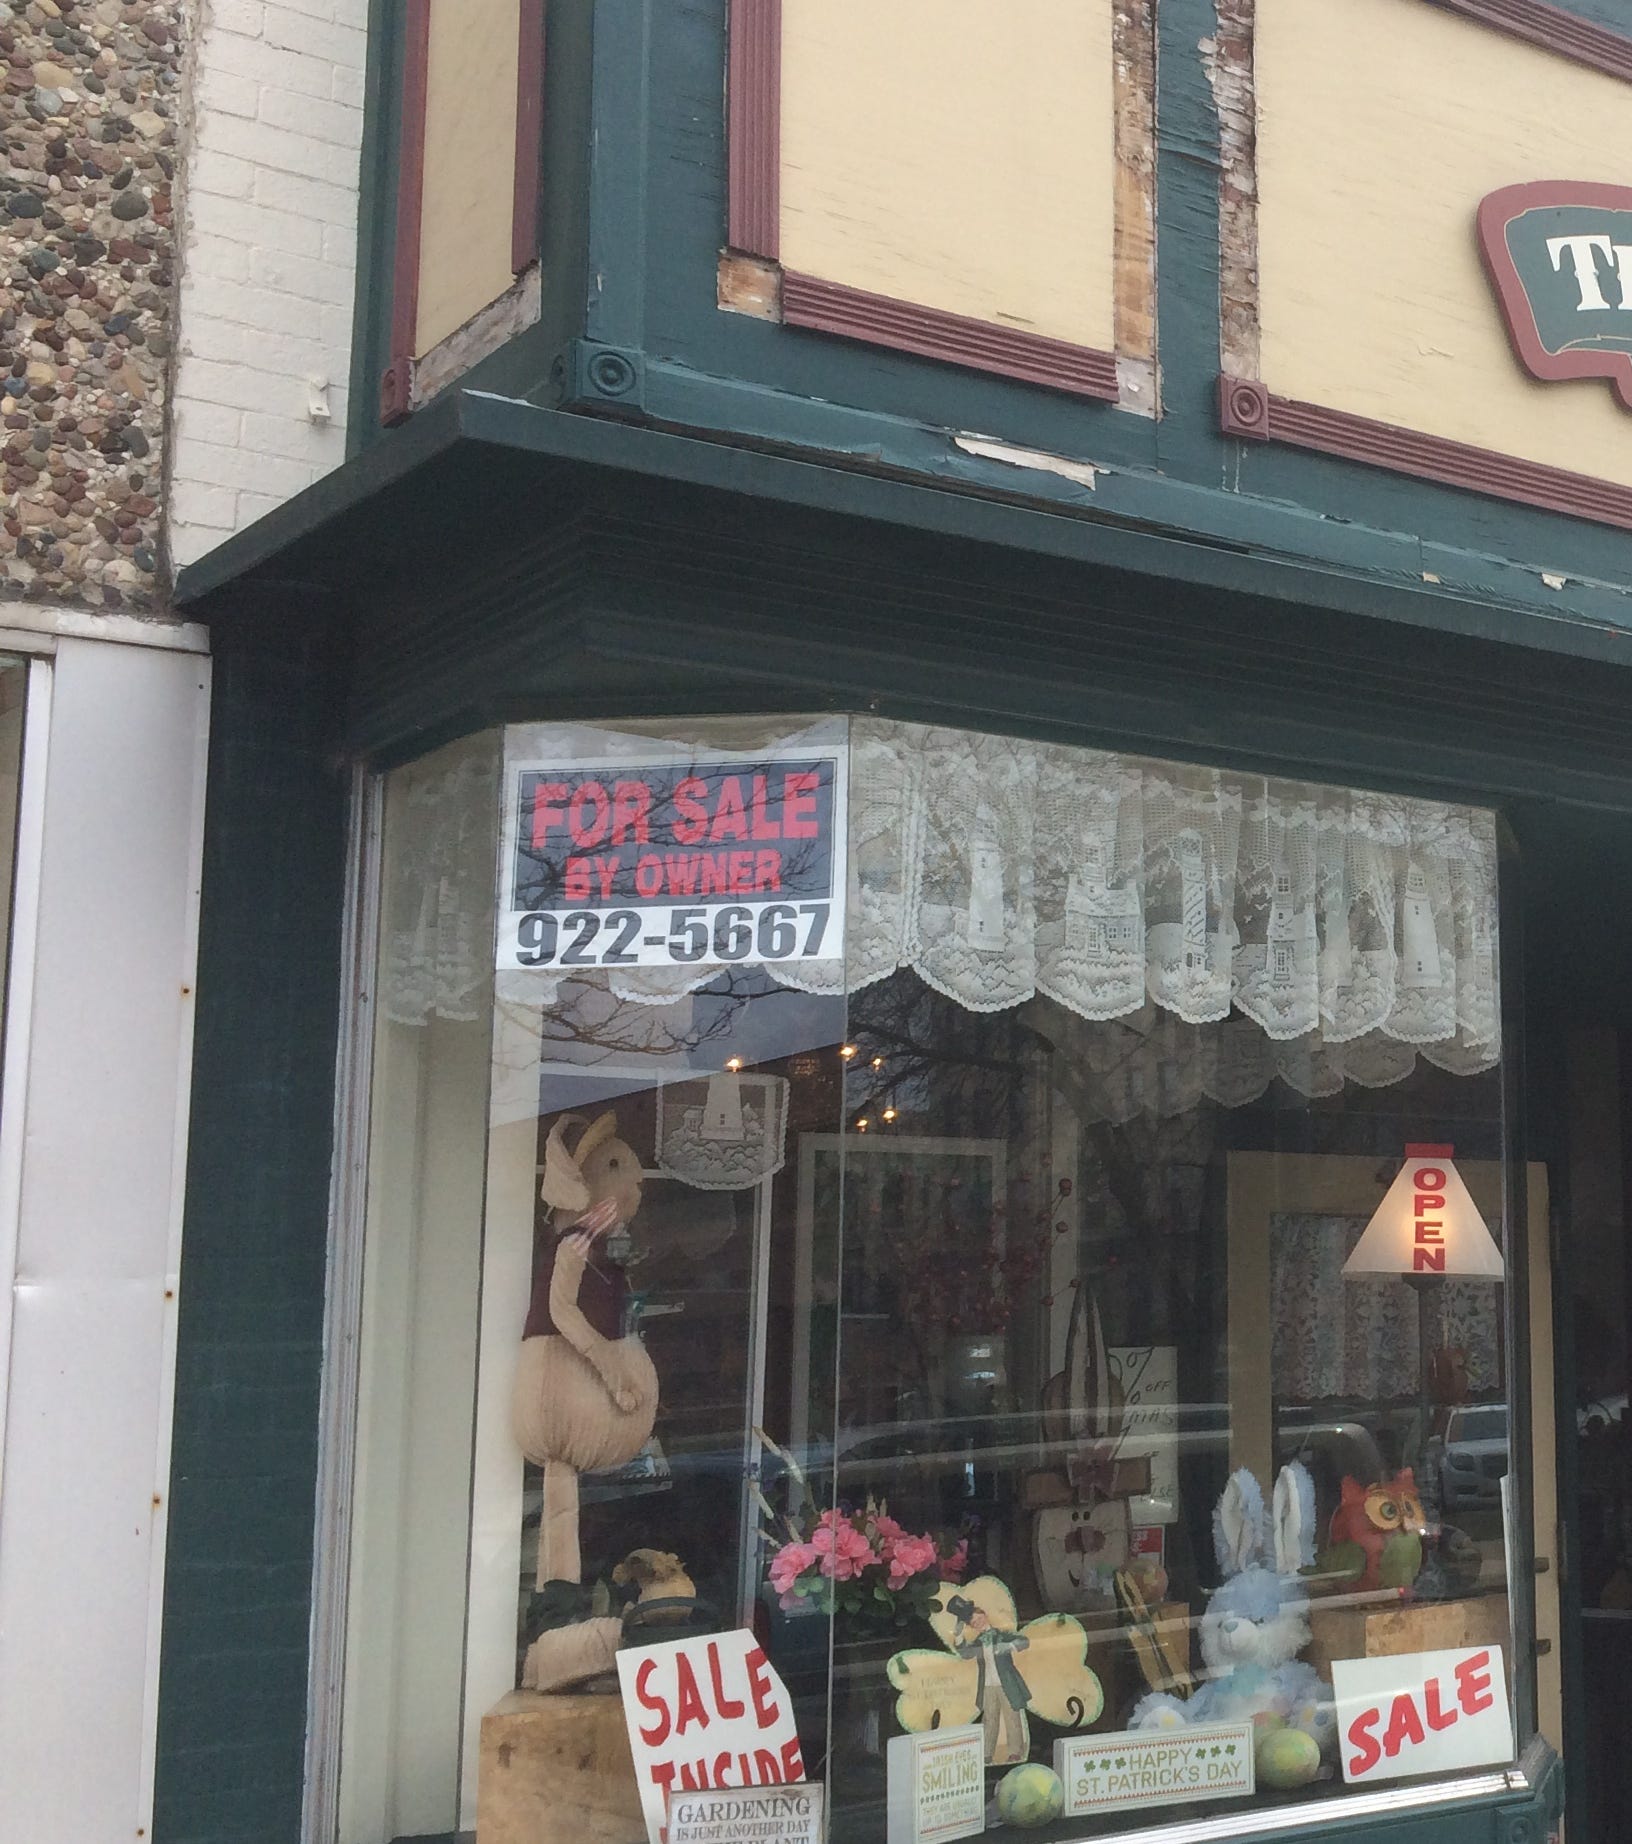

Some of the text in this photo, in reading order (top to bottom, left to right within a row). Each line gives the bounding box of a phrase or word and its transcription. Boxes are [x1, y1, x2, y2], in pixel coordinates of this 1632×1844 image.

[532, 773, 819, 849] FOR SALE
[564, 848, 782, 900] BY OWNER
[516, 904, 830, 966] 922-5667
[1413, 1168, 1447, 1271] OPEN
[1146, 1381, 1171, 1392] OFF
[635, 1642, 780, 1747] SALE
[1348, 1651, 1493, 1776] SALE
[923, 1761, 977, 1793] SMILING
[1108, 1765, 1199, 1792] PATRICK'S
[1207, 1760, 1242, 1781] DAY
[1129, 1748, 1192, 1770] HAPPY
[677, 1827, 689, 1841] IS
[691, 1825, 722, 1841] JUST
[725, 1821, 783, 1838] ANOTHER
[787, 1819, 811, 1833] DAY
[678, 1797, 811, 1824] GARDENING
